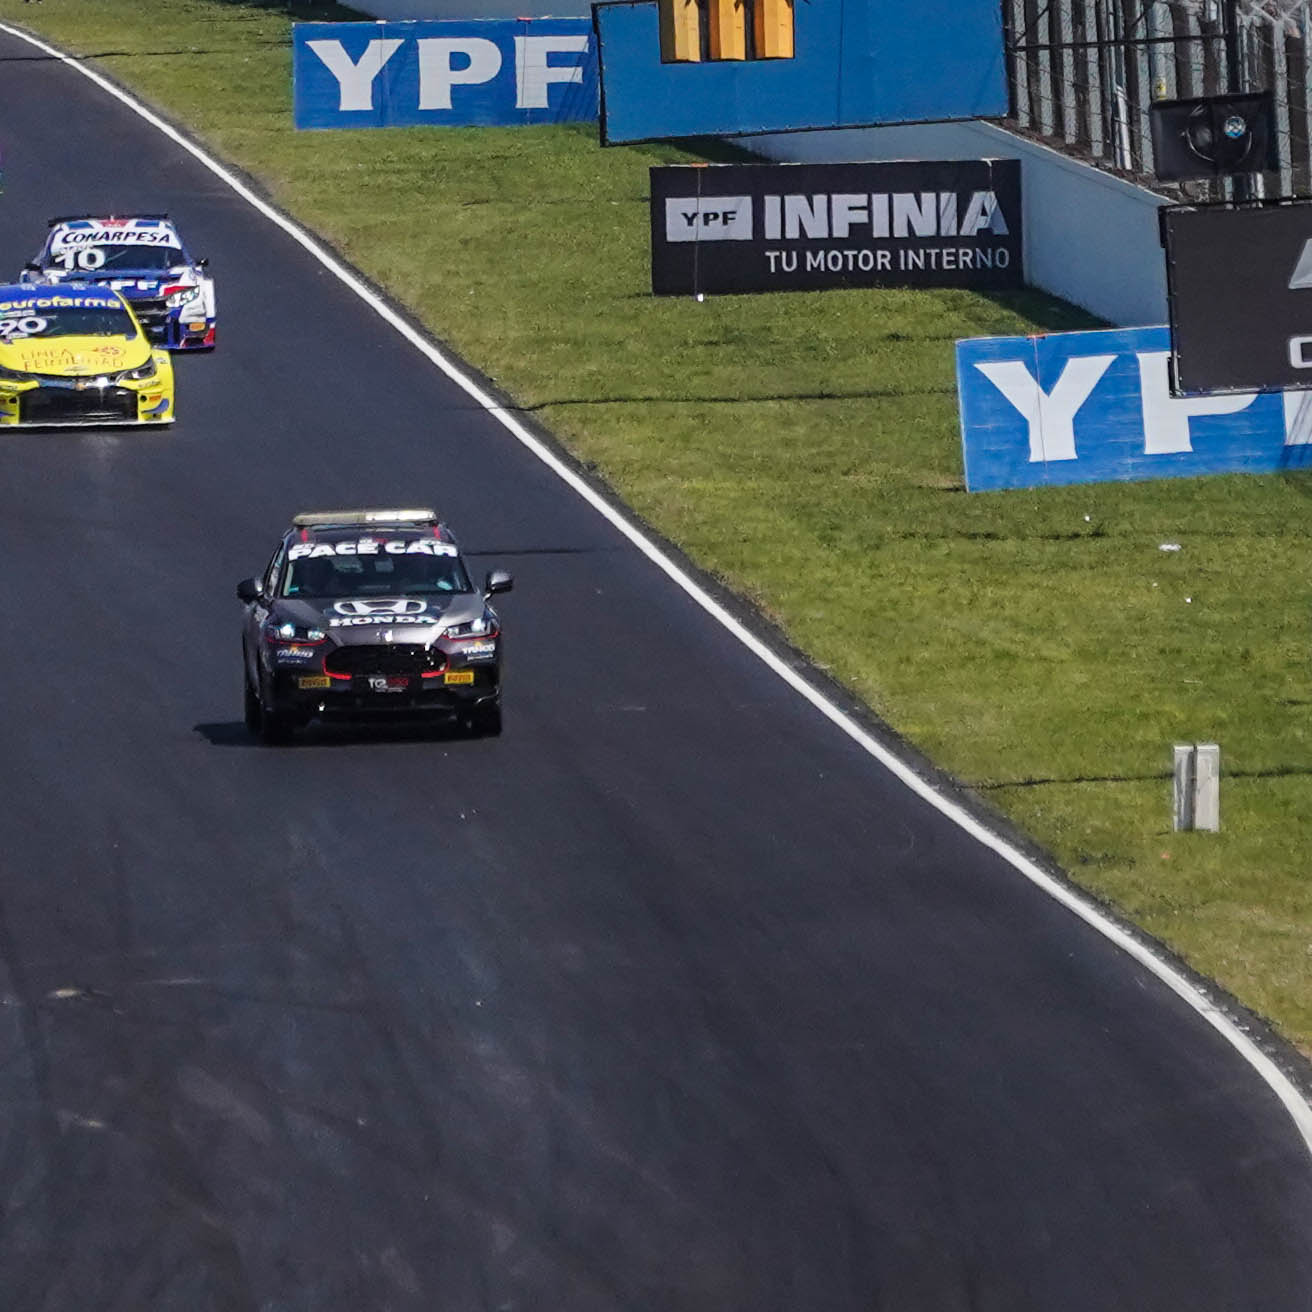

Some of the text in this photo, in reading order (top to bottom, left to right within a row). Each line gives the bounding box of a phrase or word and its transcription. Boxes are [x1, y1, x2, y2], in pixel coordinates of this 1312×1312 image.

[306, 35, 590, 112] YPF
[680, 190, 1010, 241] YPF INFINIA
[63, 232, 170, 244] CONARPESA
[55, 249, 106, 271] 10
[765, 247, 1010, 274] TU MOTOR INTERNO
[0, 296, 121, 310] eurofarma
[289, 543, 379, 560] PACE
[385, 541, 458, 557] CAR
[330, 615, 436, 626] HONDA
